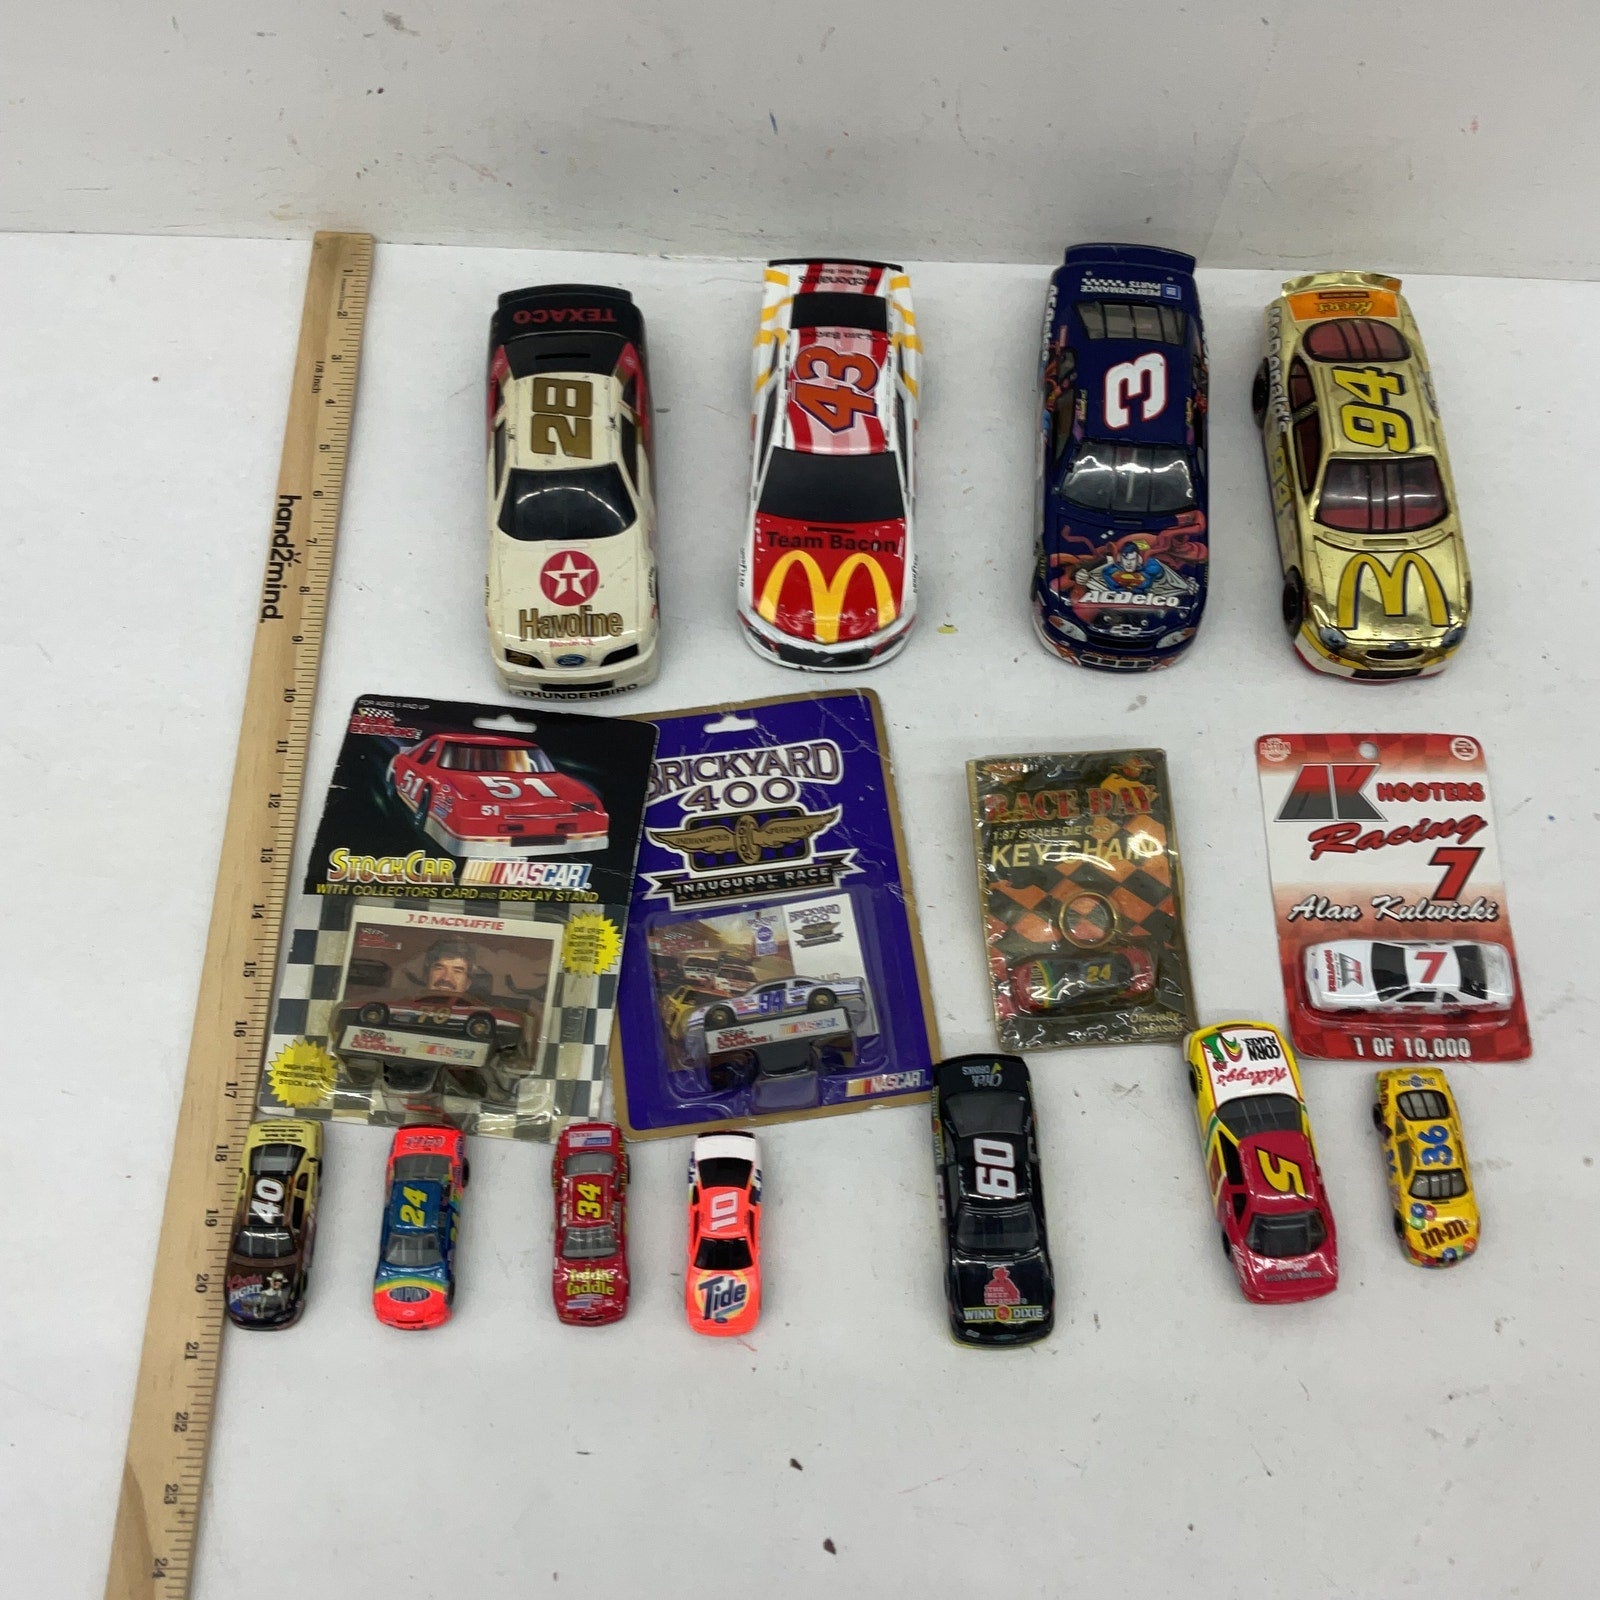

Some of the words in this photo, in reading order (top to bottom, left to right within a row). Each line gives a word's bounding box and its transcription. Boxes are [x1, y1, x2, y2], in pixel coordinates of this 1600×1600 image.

[1080, 285, 1161, 297] PERFORMANCE
[513, 307, 618, 324] TEXACO
[312, 374, 322, 394] Inch
[793, 346, 879, 433] 43
[1105, 352, 1167, 430] 3
[531, 377, 593, 460] 28
[1332, 366, 1416, 453] 94
[766, 532, 823, 549] Team
[829, 534, 897, 552] Bacon
[1079, 590, 1180, 606] ACDelco
[518, 604, 624, 642] Havoline
[284, 688, 296, 703] 10
[520, 683, 638, 700] THUNDERBIRD
[276, 740, 289, 754] 11
[648, 741, 839, 802] BRICKYARD
[400, 769, 424, 800] 51
[478, 776, 558, 798] 51
[684, 778, 797, 812] 400
[1376, 782, 1485, 802] HOOTERS
[268, 793, 281, 809] 12
[480, 804, 500, 816] 51
[984, 788, 1080, 823] RACE
[1087, 784, 1158, 817] DAY
[992, 828, 1016, 840] 1:87
[1018, 827, 1059, 838] SCALE
[1062, 826, 1082, 836] DIE
[1084, 824, 1118, 835] CAST
[1308, 814, 1488, 860] Racing
[260, 848, 273, 863] 13
[991, 842, 1051, 868] KEY
[500, 864, 584, 887] NASCAR
[676, 873, 778, 894] INAUGURAL
[784, 867, 830, 880] RACE
[1428, 847, 1486, 901] 7
[316, 883, 348, 895] WITH
[352, 884, 438, 898] COLLECTORS
[442, 887, 480, 900] CARD
[499, 888, 552, 902] DISPLAY
[554, 890, 599, 903] STAND
[251, 904, 265, 920] 14
[800, 913, 830, 924] 400
[1286, 894, 1362, 922] Alan
[1371, 894, 1500, 922] Kulwicki
[243, 961, 257, 978] 15
[1086, 964, 1112, 982] 24
[1414, 952, 1448, 984] 7
[758, 990, 786, 1014] 94
[234, 1020, 247, 1037] 16
[1241, 1036, 1276, 1046] FLAKES
[1354, 1037, 1364, 1056] 1
[1372, 1038, 1394, 1056] OF
[1402, 1037, 1472, 1060] 10,000
[1246, 1044, 1281, 1062] CORN
[871, 1070, 921, 1094] NASCAR
[1216, 1066, 1288, 1088] Kellogg's
[225, 1081, 238, 1099] 17
[215, 1144, 229, 1162] 18
[1418, 1125, 1453, 1166] 36
[973, 1137, 1018, 1199] 60
[1254, 1146, 1308, 1200] 5
[248, 1178, 284, 1224] 40
[400, 1186, 428, 1228] 24
[576, 1182, 602, 1218] 34
[205, 1208, 219, 1227] 19
[710, 1191, 739, 1232] 10
[195, 1273, 209, 1293] 20
[698, 1275, 748, 1321] Tide
[964, 1309, 995, 1320] WINN
[1013, 1308, 1043, 1318] DIXIE
[184, 1341, 199, 1360] 21
[174, 1412, 188, 1432] 22
[163, 1483, 179, 1505] 23
[152, 1558, 168, 1578] 24
